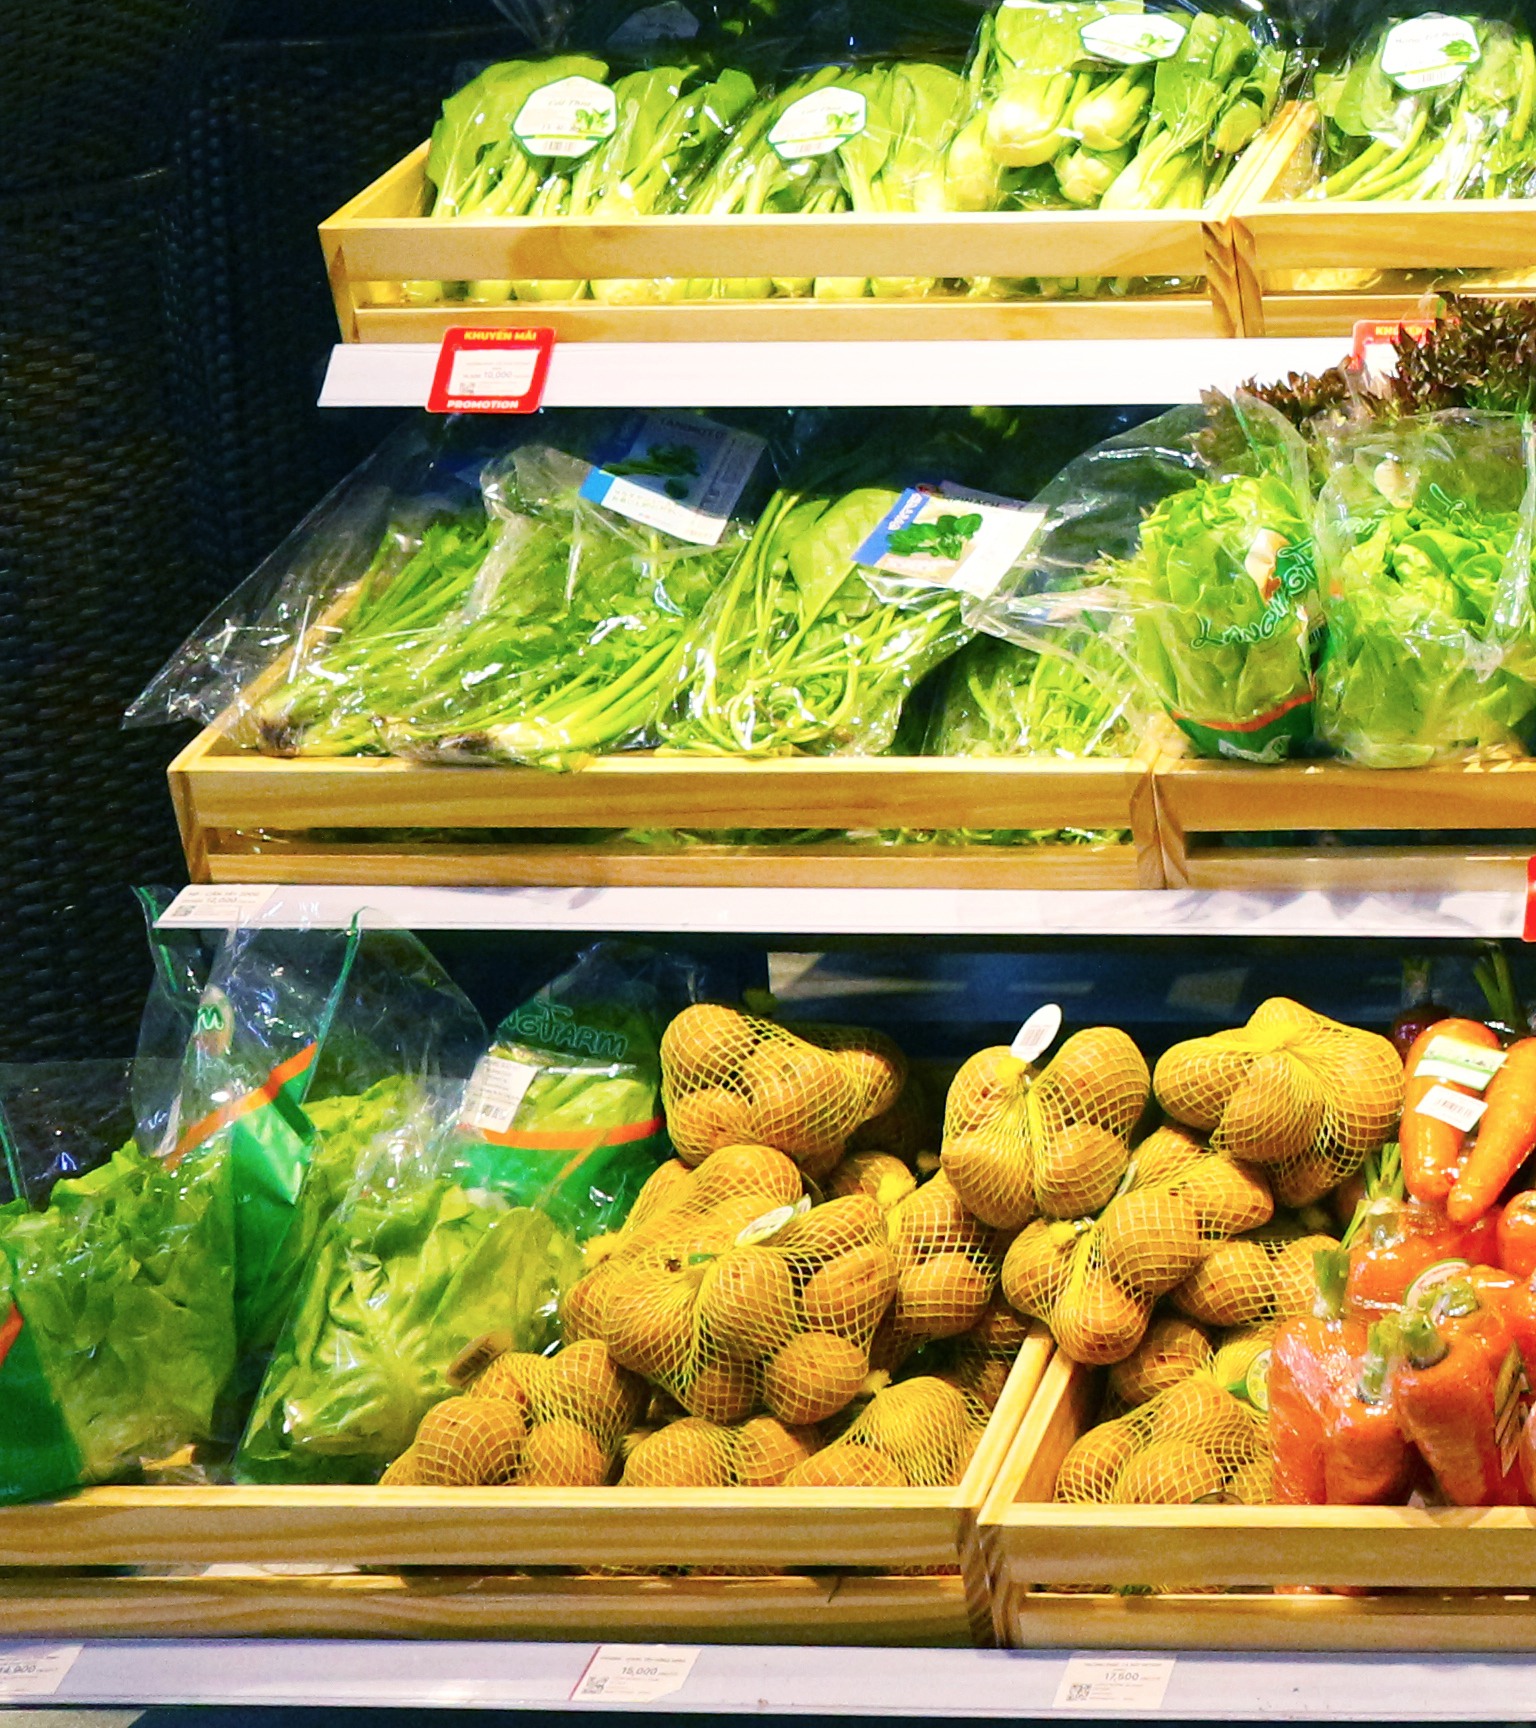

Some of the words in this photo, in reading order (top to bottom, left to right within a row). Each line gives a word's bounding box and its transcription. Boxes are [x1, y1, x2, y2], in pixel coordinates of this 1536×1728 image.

[464, 330, 512, 341] KHUYẾN
[514, 330, 537, 341] MÃI
[446, 399, 519, 410] PROMOTION
